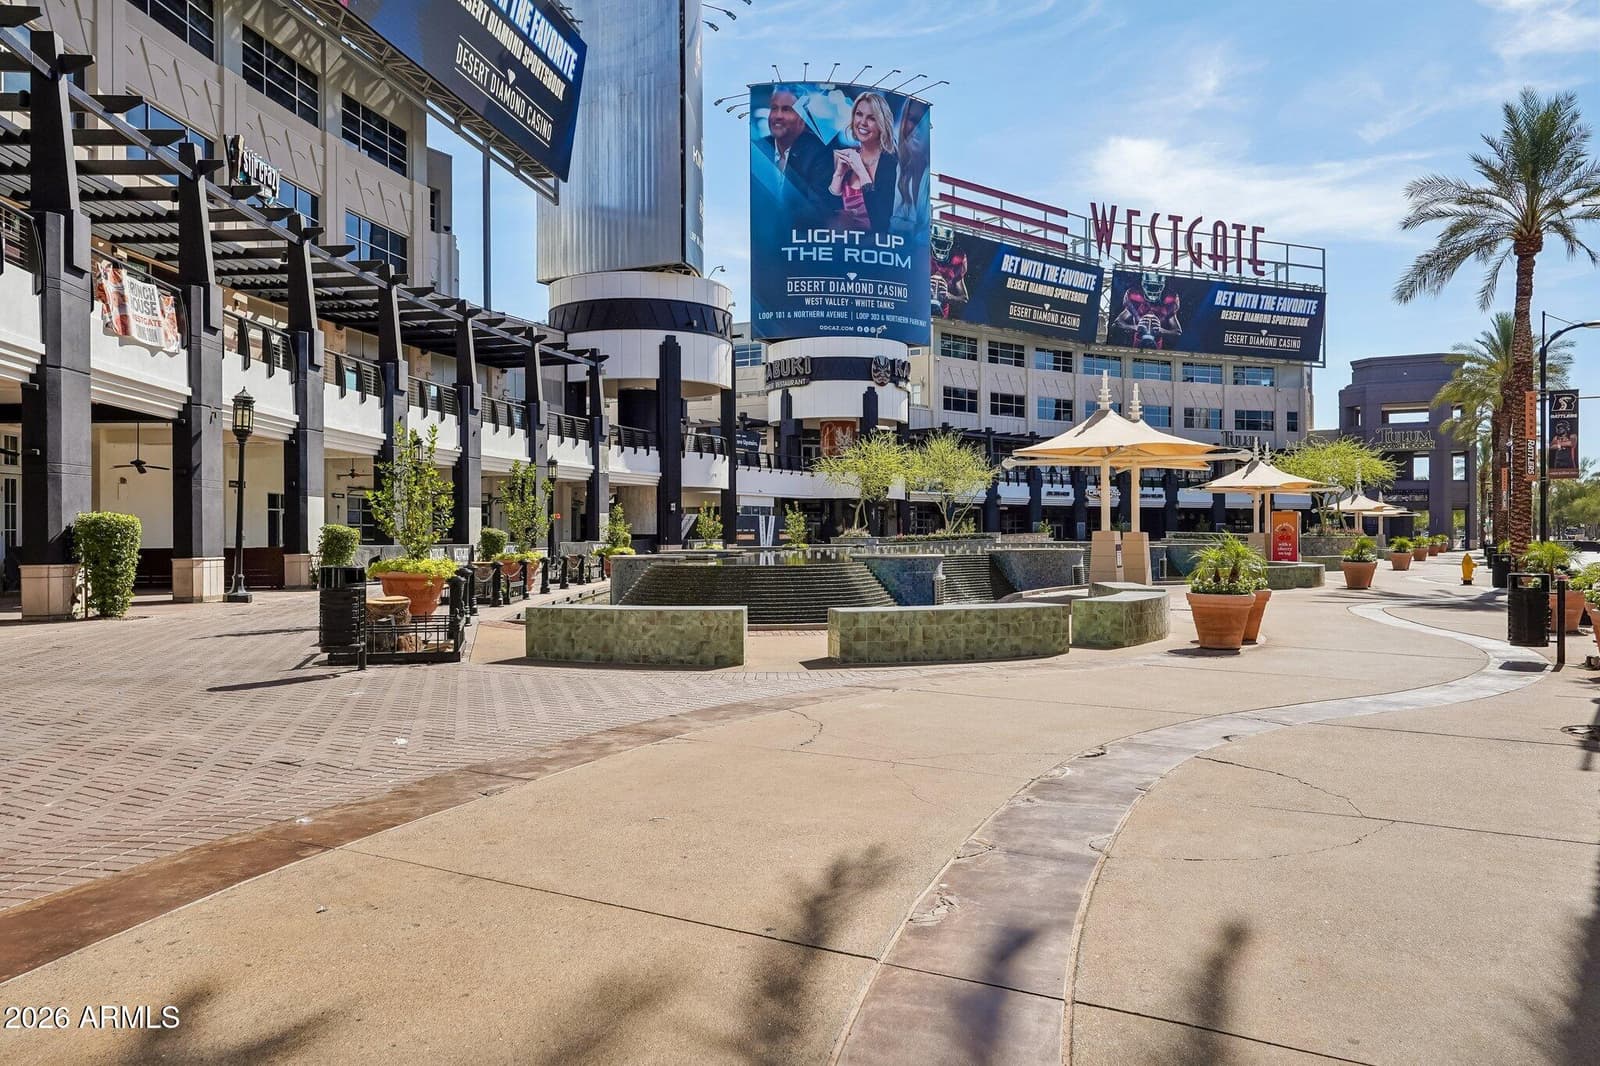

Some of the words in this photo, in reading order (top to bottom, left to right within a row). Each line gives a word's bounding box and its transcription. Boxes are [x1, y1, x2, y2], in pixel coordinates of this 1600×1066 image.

[486, 10, 524, 60] DIAMOND
[522, 45, 566, 100] SPORTSBOOK
[528, 8, 578, 81] FAVORITE
[455, 43, 490, 87] DESERT
[490, 72, 526, 119] DIAMOND
[526, 104, 553, 142] CASINO
[791, 228, 865, 245] LIGHT
[875, 233, 904, 249] UP
[1090, 201, 1266, 277] WESTGATE
[781, 247, 833, 262] THE
[844, 248, 912, 269] ROOM
[1001, 254, 1022, 275] BET
[1019, 258, 1044, 279] WITH
[1043, 263, 1061, 283] THE
[1058, 267, 1098, 291] FAVORITE
[787, 280, 825, 292] DESERT
[829, 281, 874, 295] DIAMOND
[877, 284, 908, 298] CASINO
[1006, 277, 1029, 291] DESERT
[1028, 282, 1055, 297] DIAMOND
[1053, 287, 1089, 304] SPORTSBOOK
[804, 297, 823, 306] WEST
[824, 297, 849, 306] VALLEY
[854, 299, 875, 308] WHITE
[876, 300, 895, 310] TANKS
[1214, 290, 1235, 306] BET
[1233, 292, 1260, 309] WITH
[1259, 294, 1278, 311] THE
[1276, 296, 1319, 315] FAVORITE
[793, 310, 825, 318] NORTHERN
[856, 312, 869, 320] LOOP
[886, 315, 909, 323] NORTHERN
[1009, 304, 1032, 320] DESERT
[1032, 309, 1059, 324] DIAMOND
[1060, 314, 1080, 328] CASINO
[1220, 309, 1245, 321] DESERT
[1243, 312, 1272, 324] DIAMOND
[1271, 315, 1310, 327] SPORTSBOOK
[1224, 333, 1248, 345] DESERT
[1249, 336, 1278, 347] DIAMOND
[1278, 339, 1301, 349] CASINO
[766, 356, 812, 380] ABUKI
[1375, 428, 1433, 443] TULUM
[1527, 439, 1536, 475] RATTLERS
